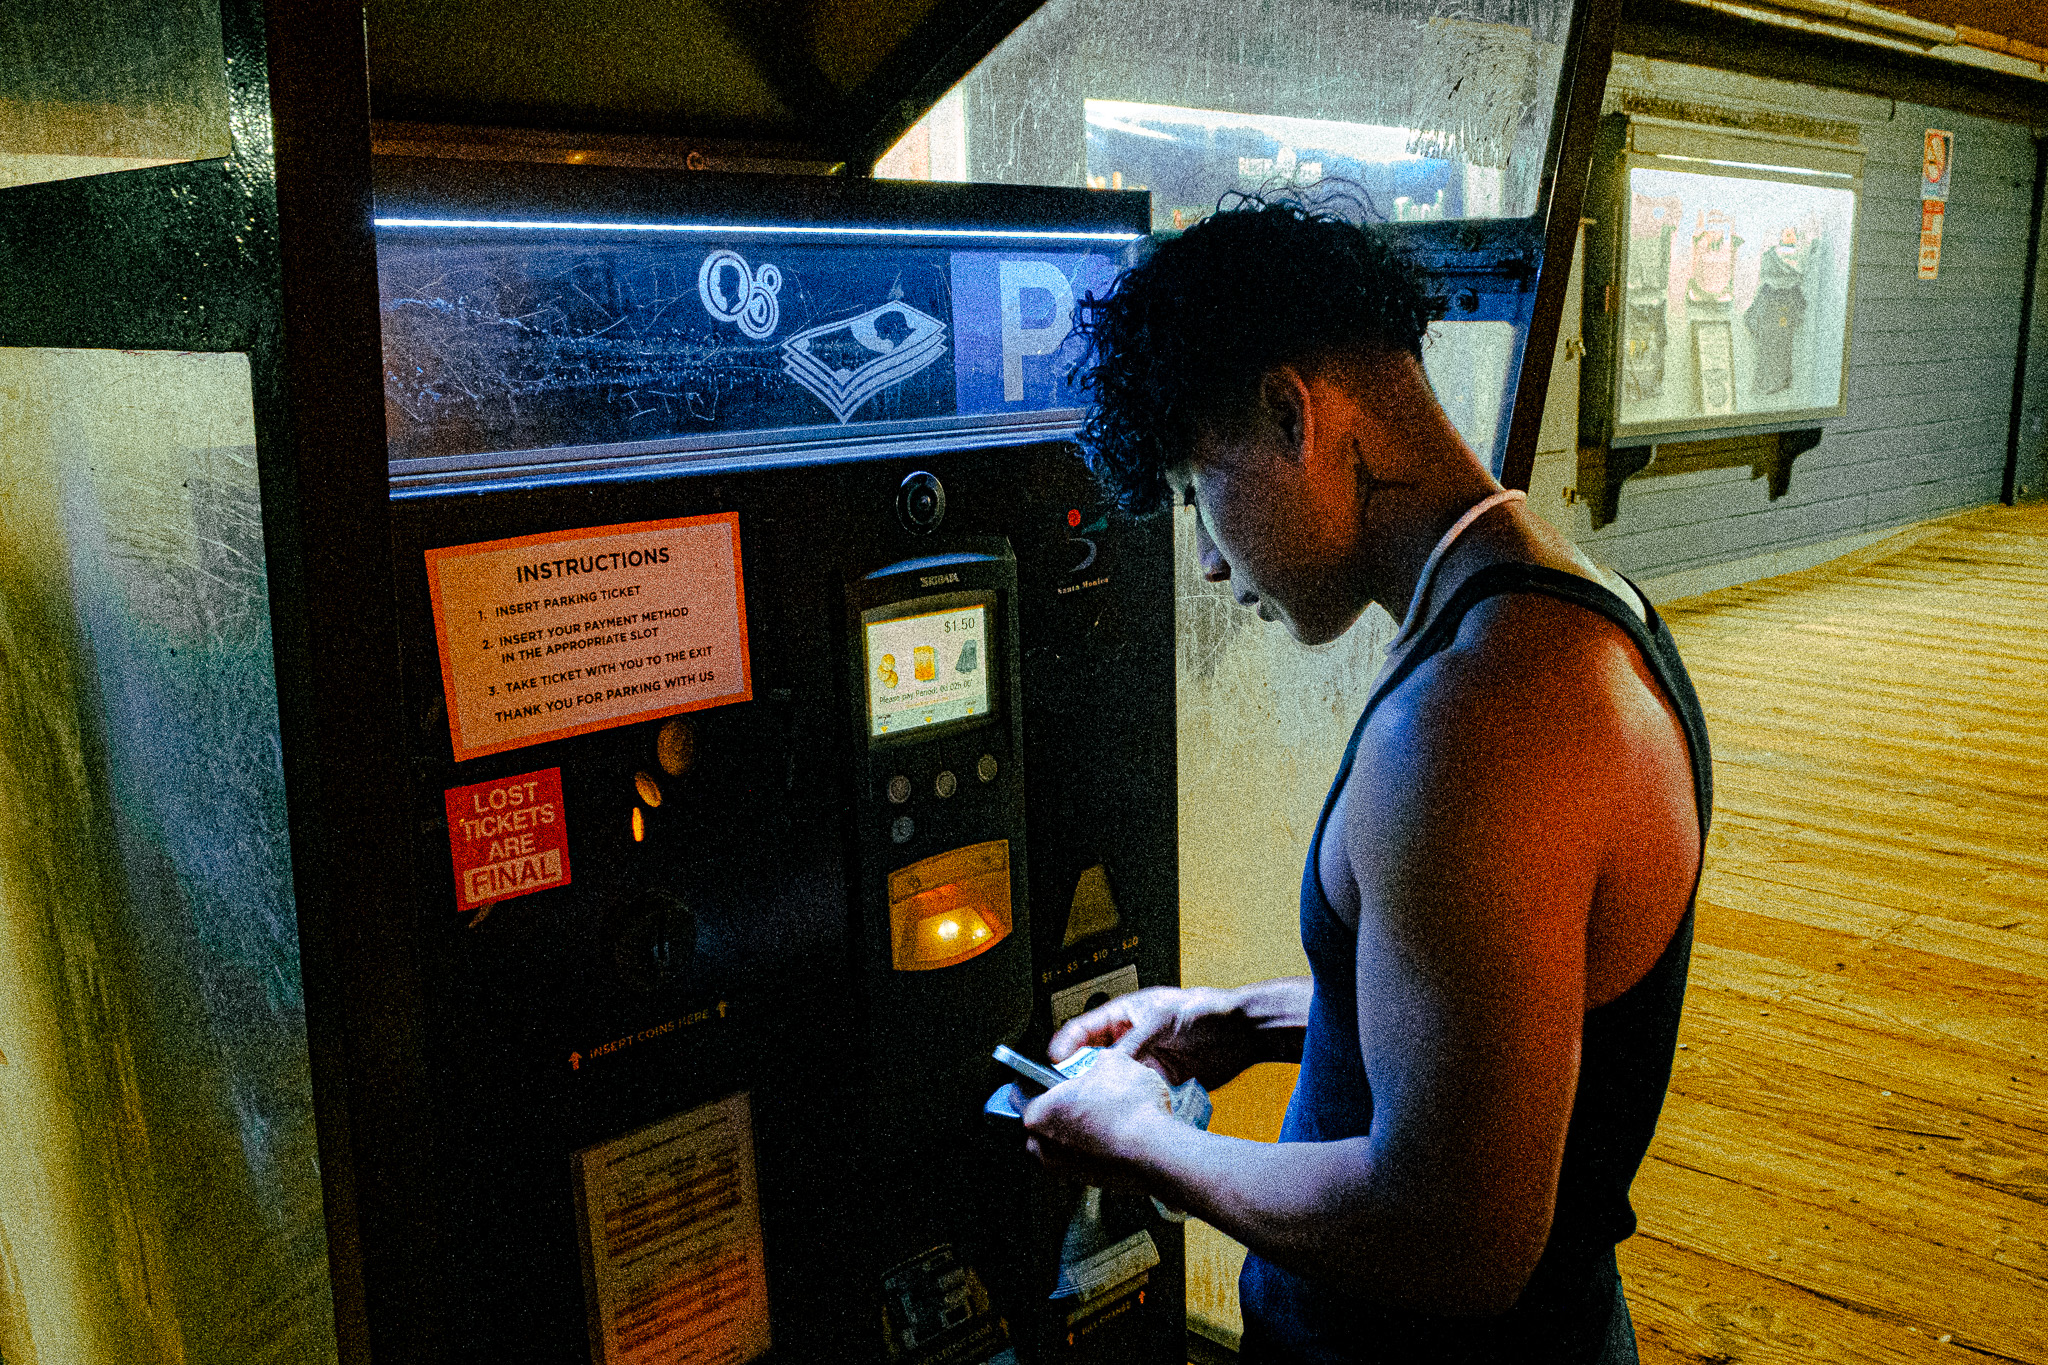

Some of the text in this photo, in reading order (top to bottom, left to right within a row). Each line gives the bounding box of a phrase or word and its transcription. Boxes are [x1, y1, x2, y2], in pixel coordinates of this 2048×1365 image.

[1000, 260, 1075, 402] P
[517, 547, 669, 583] INSTRUCTIONS
[478, 586, 640, 621] 1. INSERT PARKING TICKET
[482, 606, 688, 650] 2. INSERT YOUR PAYMENT METHOD
[944, 617, 975, 633] $1.50
[502, 628, 658, 663] IN THE APPROPRIATE SLOT
[488, 646, 711, 697] 3. TAKE TICKET WITH YOU TO THE EXIT
[496, 671, 714, 722] THANK YOU FOR PARKING WITH US
[880, 694, 899, 704] Please
[902, 691, 914, 702] pay
[474, 782, 538, 813] LOST
[460, 803, 555, 841] TICKETS
[489, 833, 536, 861] ARE
[472, 856, 558, 897] FINAL
[1093, 949, 1108, 962] $10
[1122, 936, 1138, 950] $20
[590, 1009, 709, 1059] INSERT COINS HERE
